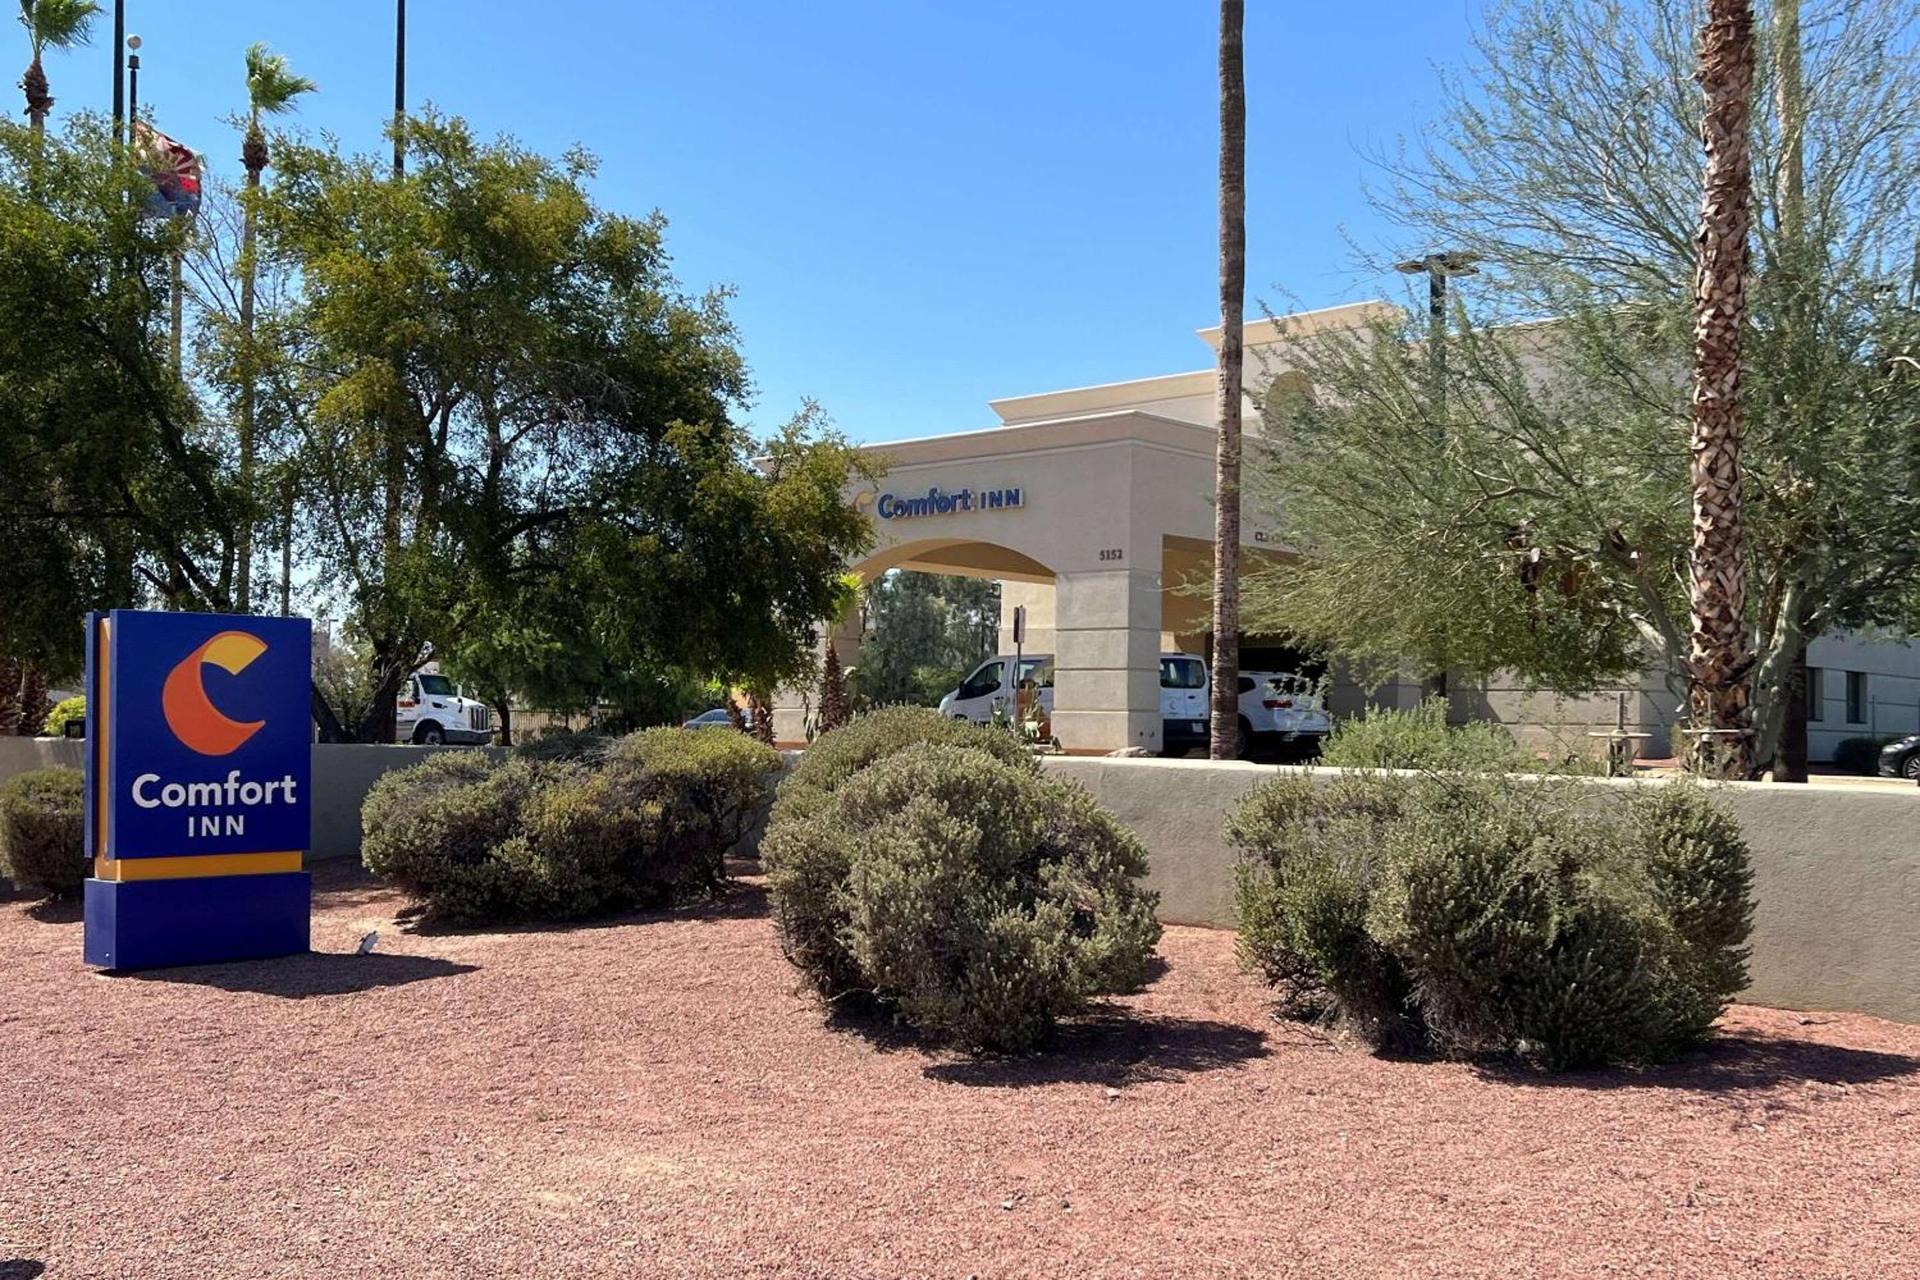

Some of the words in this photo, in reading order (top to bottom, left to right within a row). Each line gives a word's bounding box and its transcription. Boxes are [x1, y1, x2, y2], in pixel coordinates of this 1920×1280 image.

[878, 487, 972, 518] Comfort
[980, 488, 1020, 509] INN
[131, 770, 297, 808] Comfort
[188, 815, 245, 837] INN
